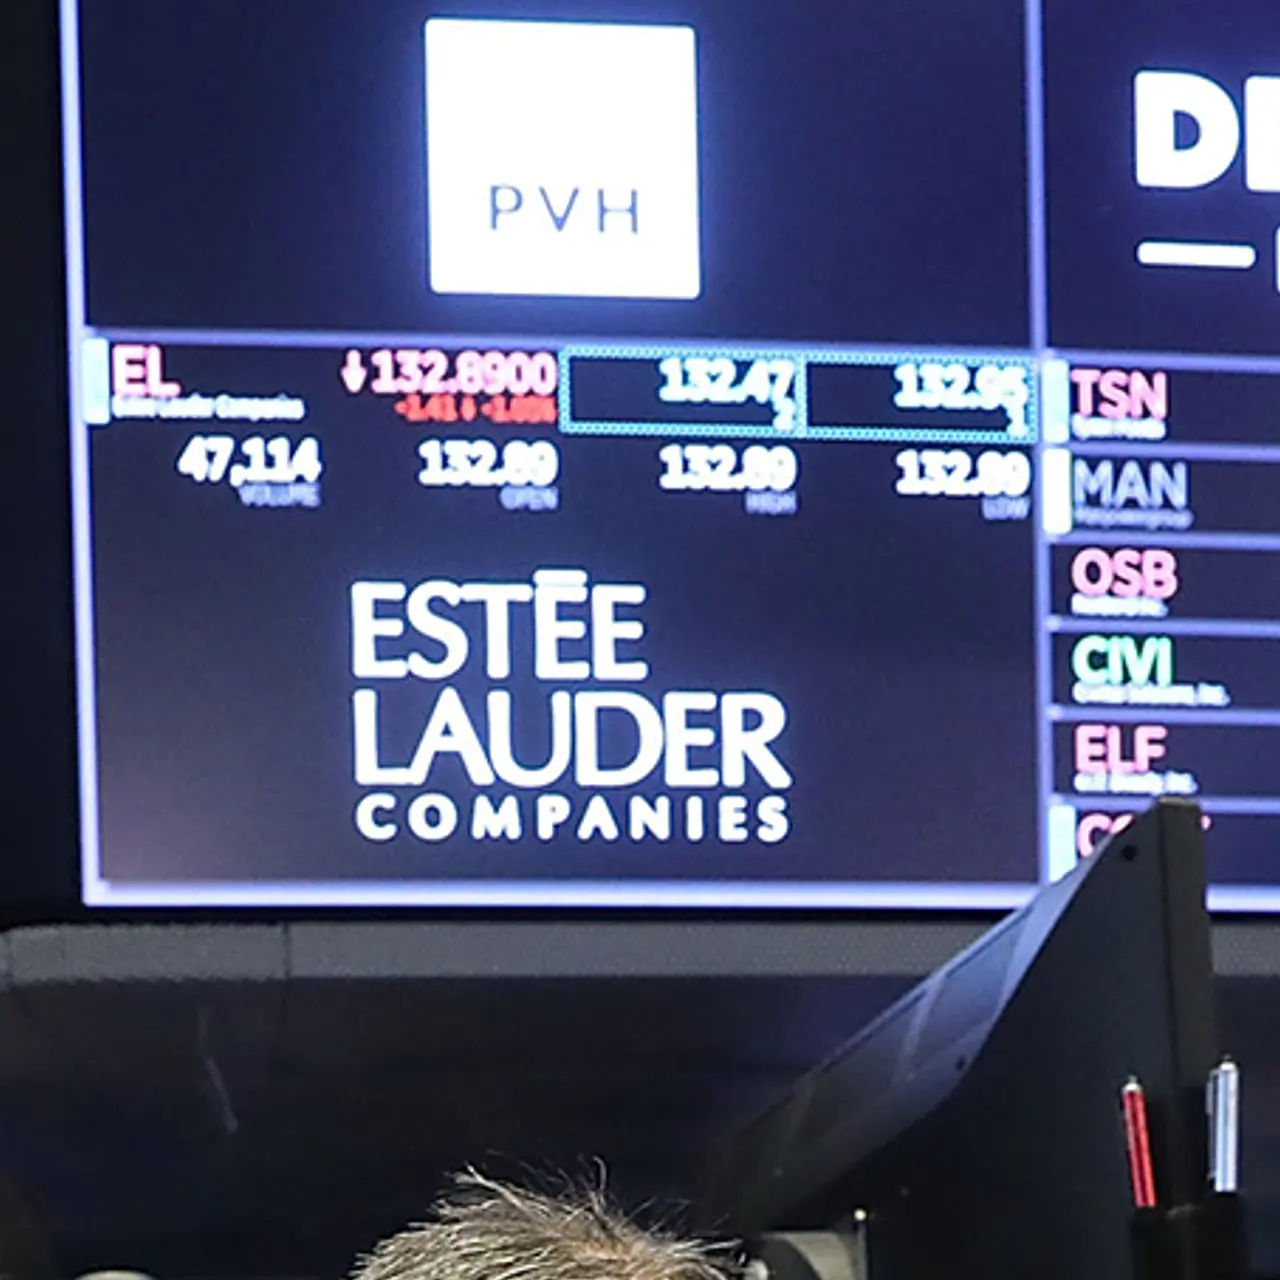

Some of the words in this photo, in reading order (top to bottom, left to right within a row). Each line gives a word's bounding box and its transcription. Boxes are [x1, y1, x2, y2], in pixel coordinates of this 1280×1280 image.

[488, 184, 640, 234] PVH
[113, 345, 180, 397] EL
[372, 349, 558, 394] 132.8900
[659, 357, 795, 403] 132.47
[1071, 368, 1167, 419] TSN
[178, 436, 322, 487] 47,114
[1072, 459, 1189, 508] MAN
[1072, 549, 1178, 598] OSB
[352, 686, 793, 790] LAUDER
[1075, 725, 1169, 774] ELF
[355, 793, 791, 843] COMPANIES
